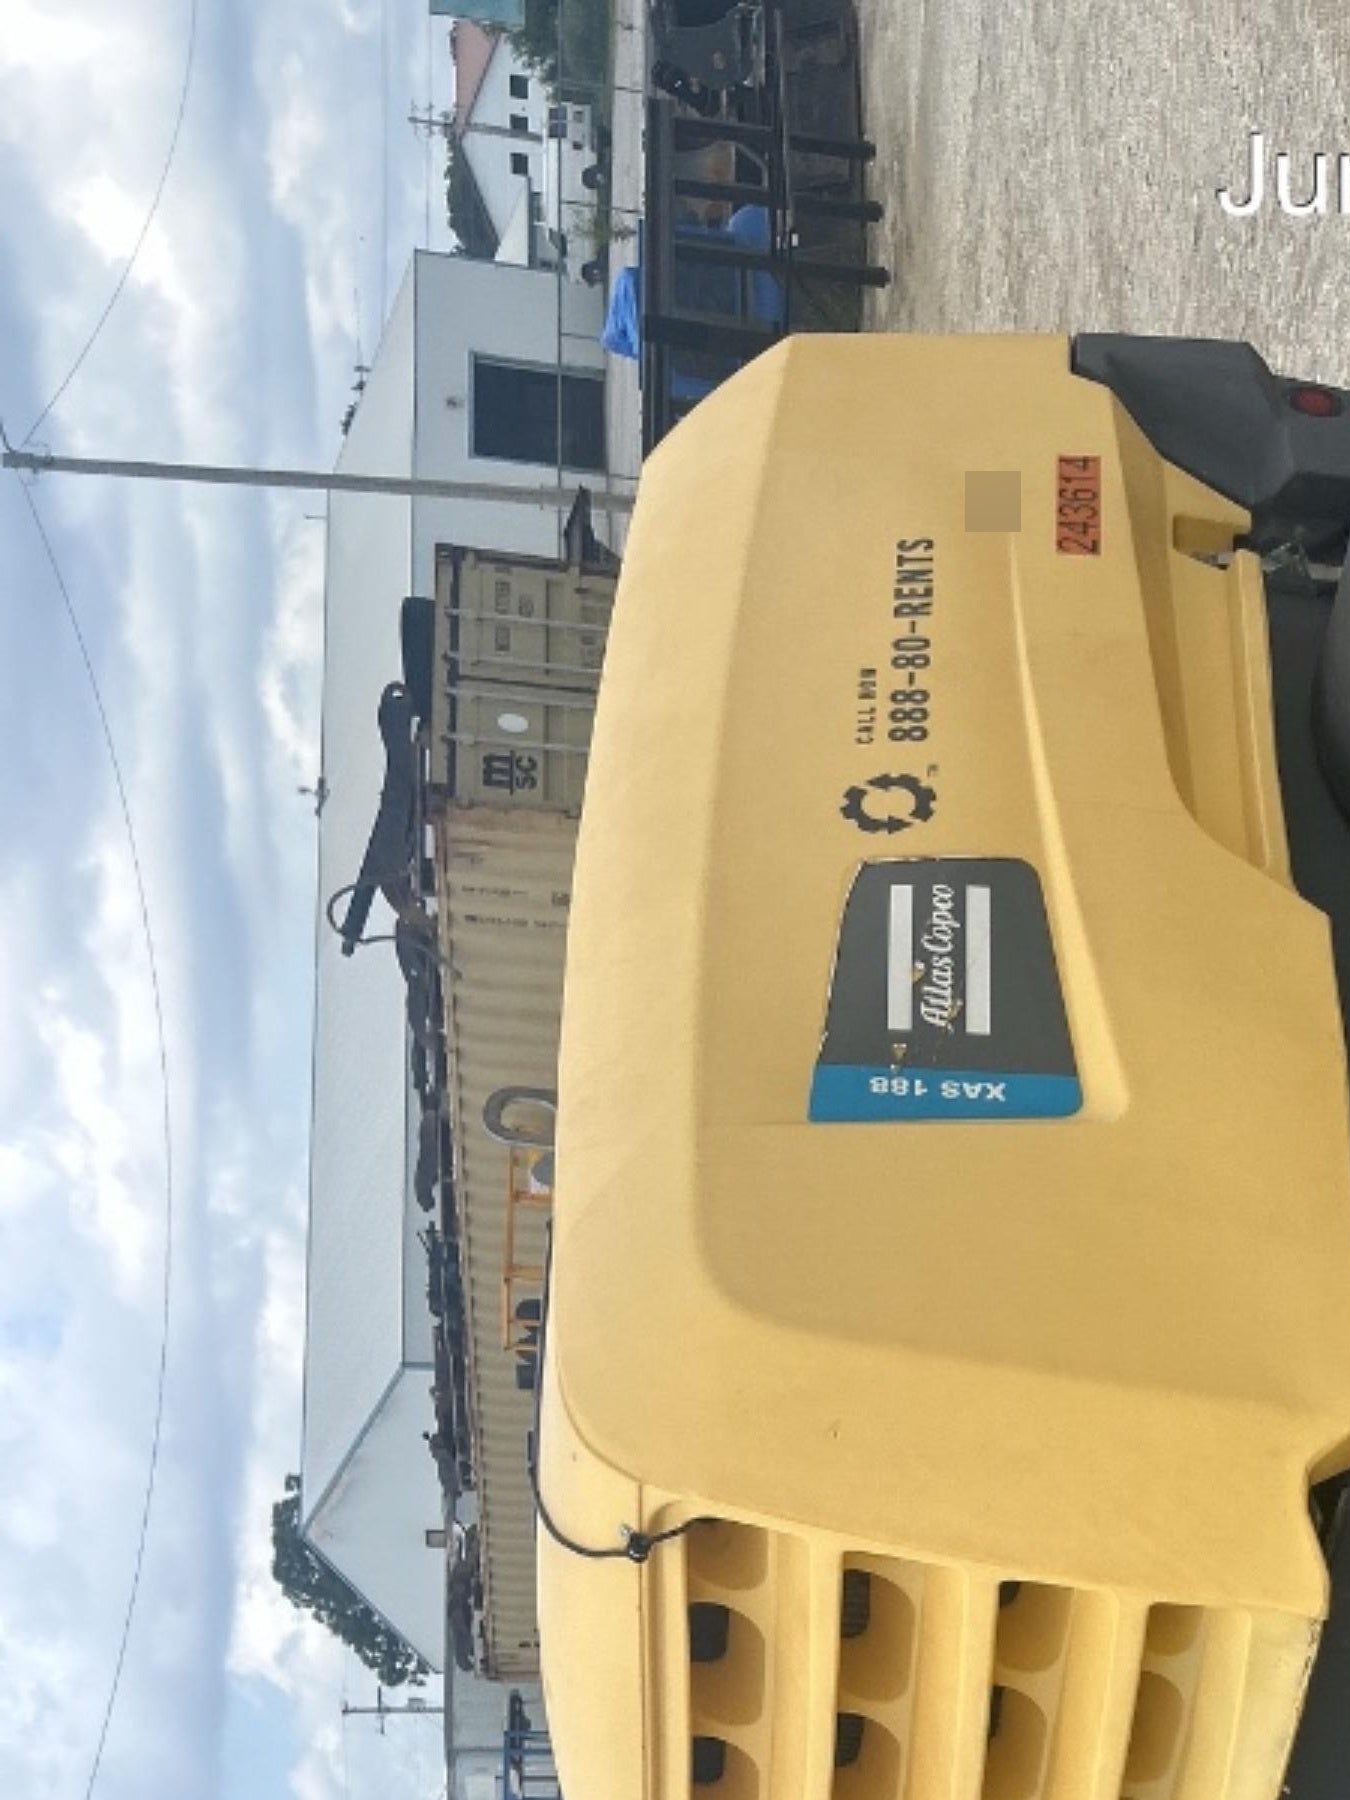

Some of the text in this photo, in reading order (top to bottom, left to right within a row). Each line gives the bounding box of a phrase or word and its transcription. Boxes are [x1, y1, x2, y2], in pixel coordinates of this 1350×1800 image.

[1058, 456, 1099, 554] 243614
[887, 538, 934, 742] 888-80-RENTS
[855, 706, 876, 745] CALL
[941, 1079, 1007, 1102] XAS
